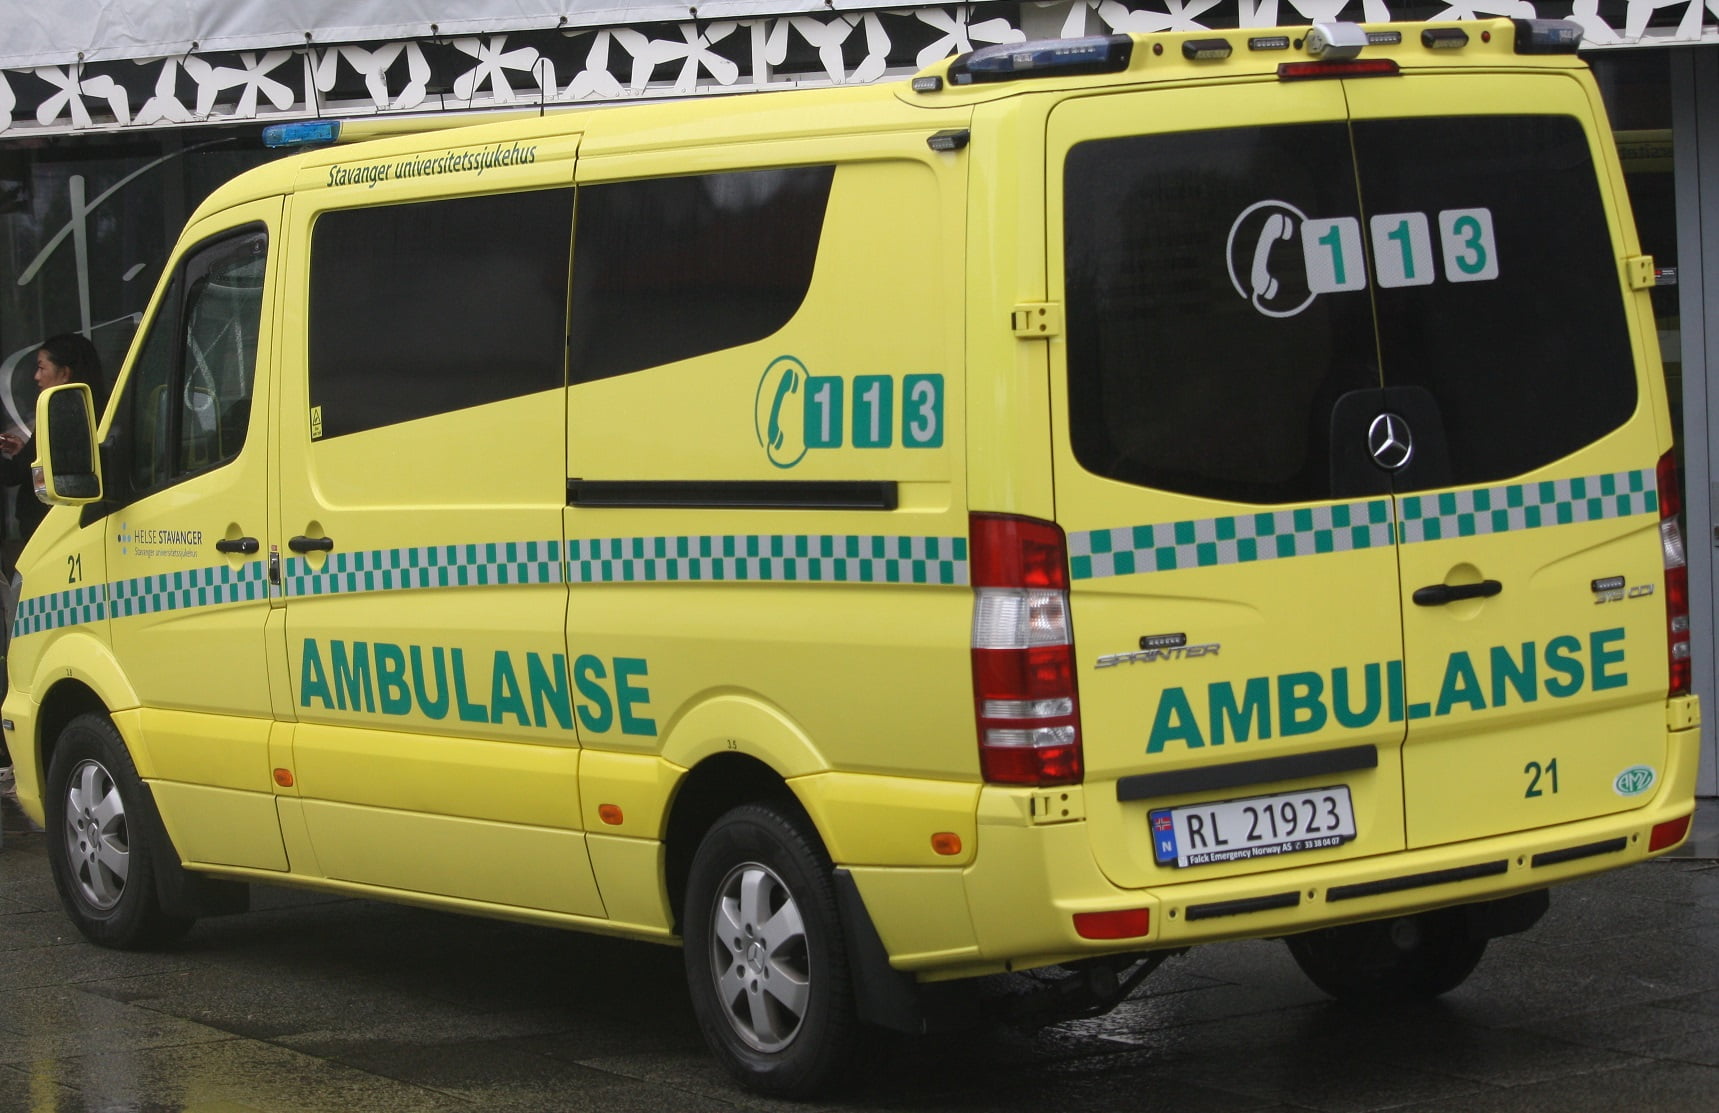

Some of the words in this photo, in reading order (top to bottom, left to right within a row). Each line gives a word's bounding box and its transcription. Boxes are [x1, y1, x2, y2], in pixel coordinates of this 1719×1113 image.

[326, 164, 392, 189] Stavanger
[394, 141, 537, 180] universitetssjukehus
[134, 529, 157, 544] HELSE
[158, 530, 203, 545] STAVANGER
[134, 546, 155, 559] Stavanger
[67, 553, 83, 584] 21
[1628, 583, 1655, 600] CDI
[1094, 643, 1220, 670] SPRINTER
[300, 637, 658, 737] AMBULANSE
[1145, 627, 1629, 754] AMBULANSE
[1523, 757, 1558, 799] 21
[1186, 811, 1228, 850] RL
[1242, 796, 1341, 841] 21923
[1161, 841, 1172, 852] N
[1189, 854, 1210, 865] Falck
[1210, 849, 1251, 862] Emergency
[1252, 845, 1281, 858] Norway
[1282, 843, 1292, 852] AS
[1304, 840, 1313, 849] 33
[1313, 839, 1322, 848] 38
[1322, 838, 1331, 847] 04
[1331, 836, 1340, 845] 07
